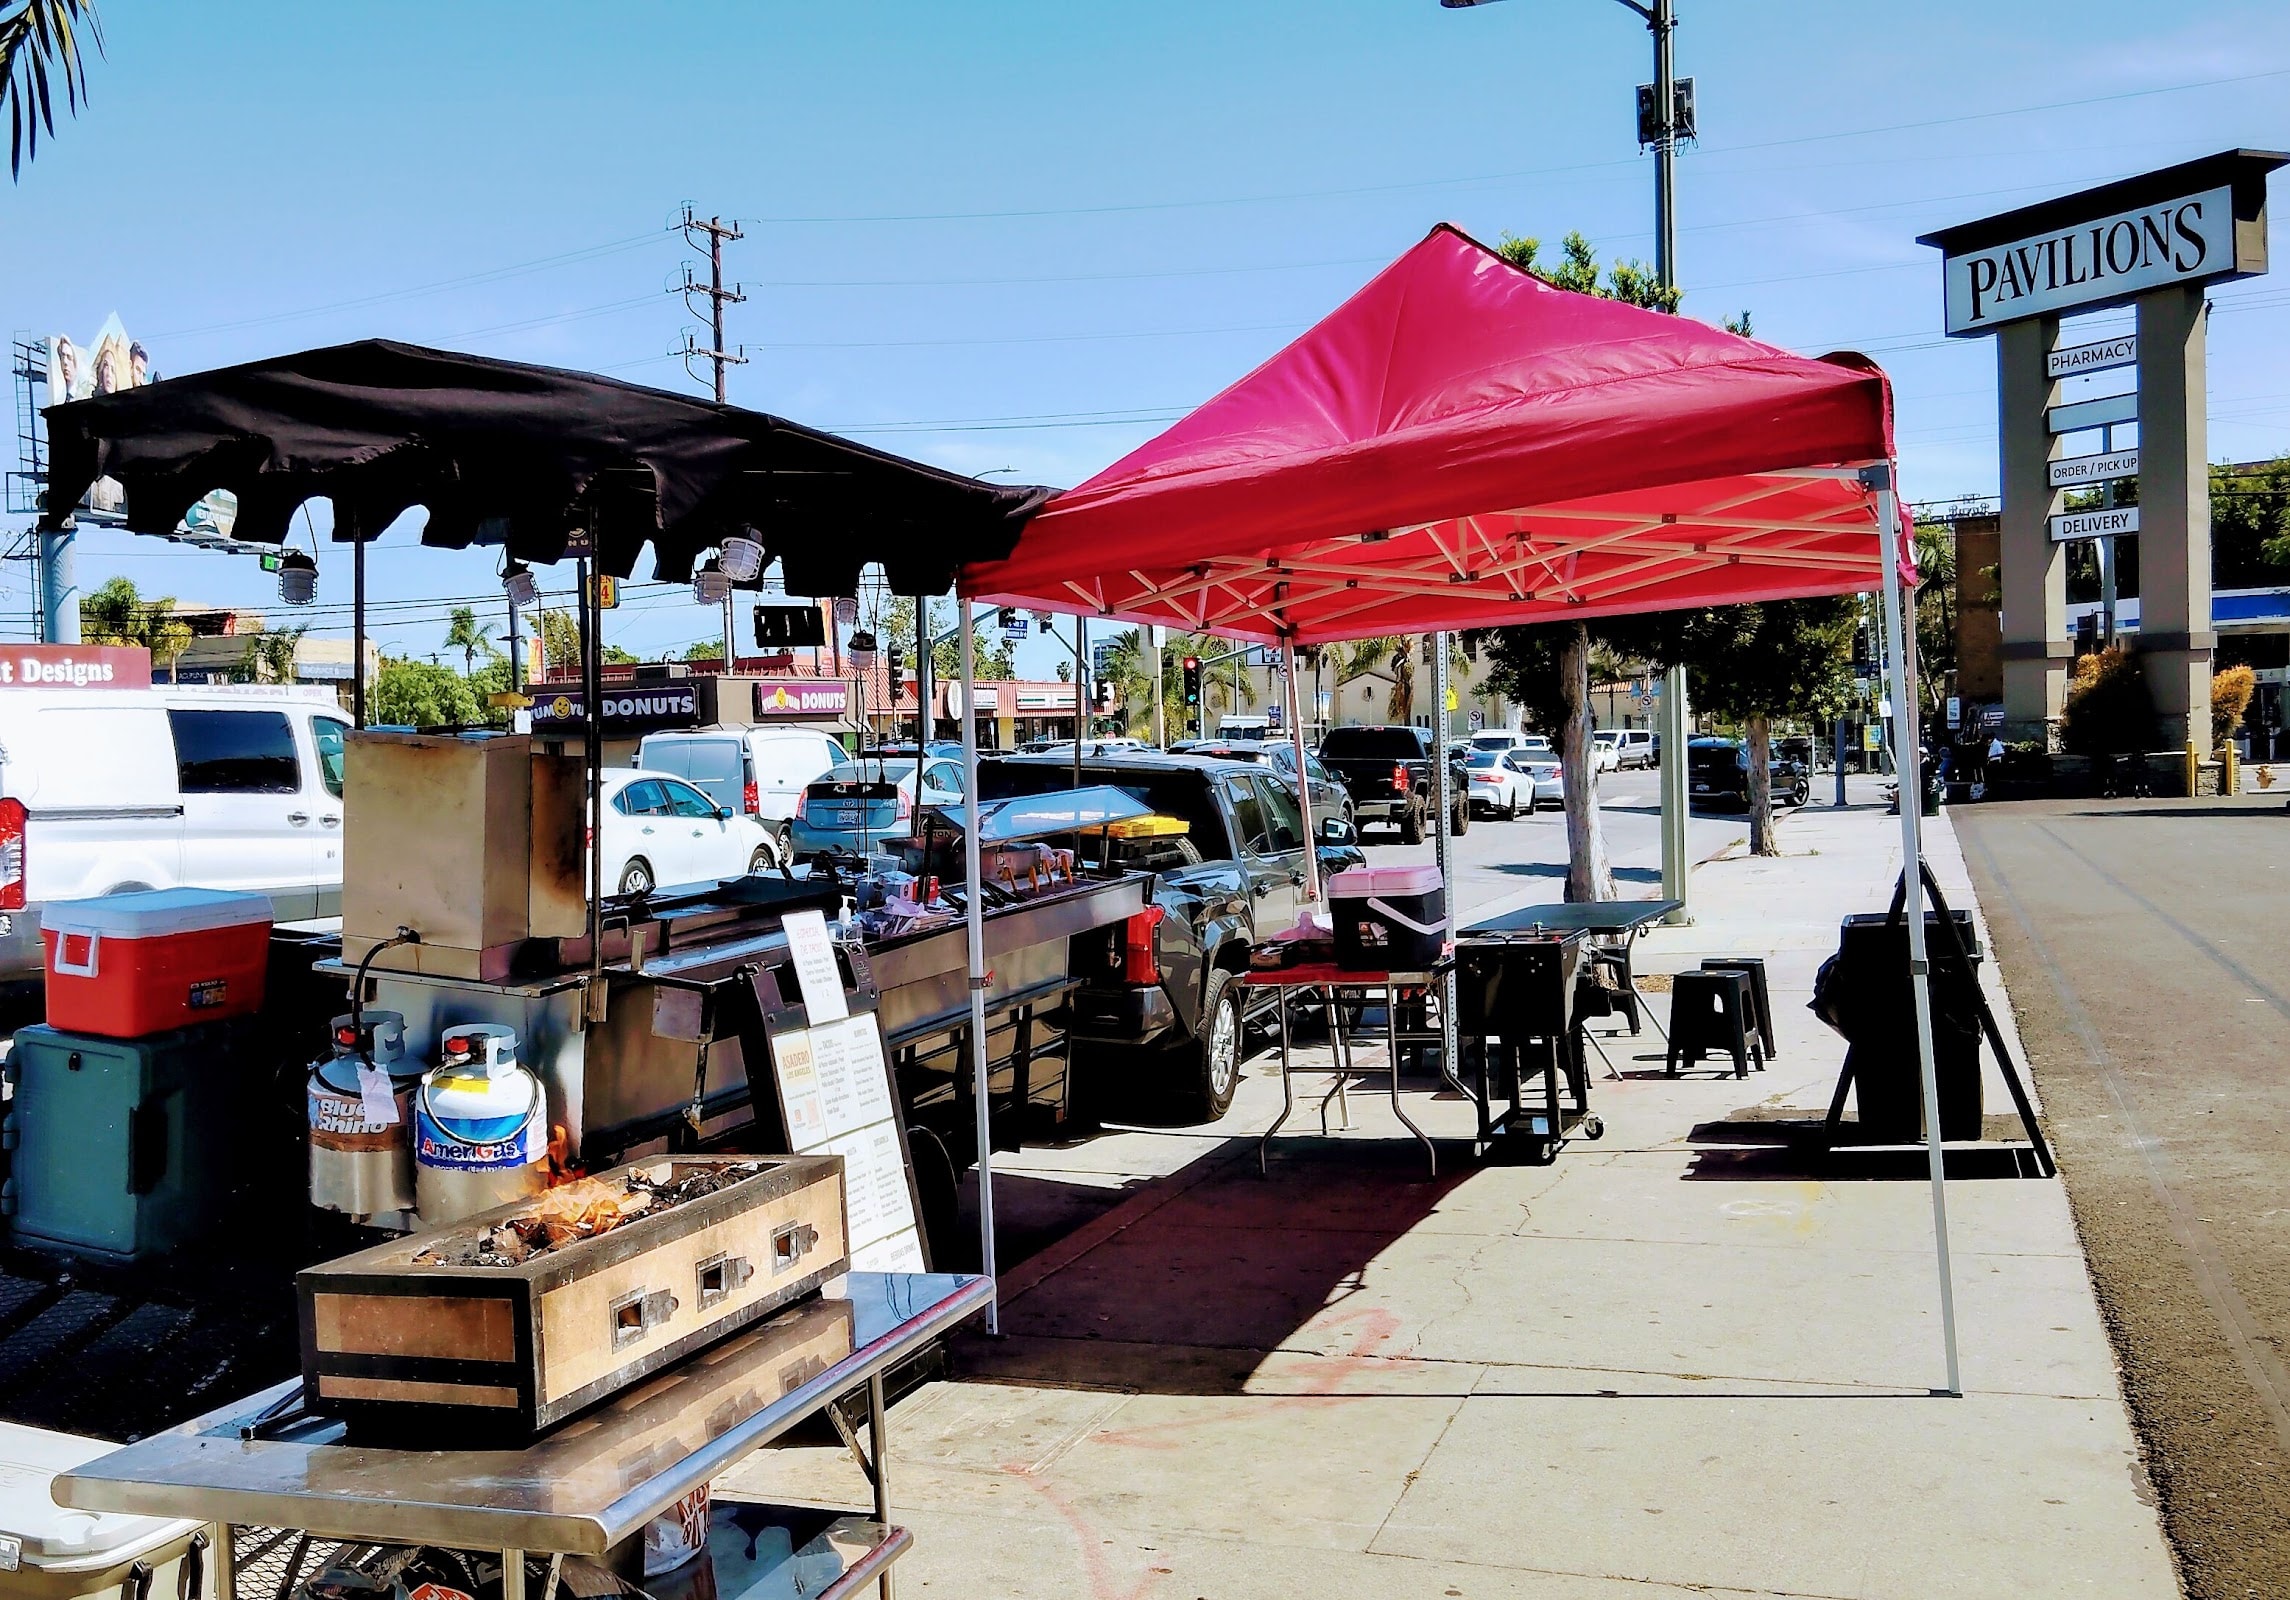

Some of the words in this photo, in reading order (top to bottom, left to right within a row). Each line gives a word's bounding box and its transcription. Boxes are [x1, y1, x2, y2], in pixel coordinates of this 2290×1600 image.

[1966, 202, 2207, 322] PAVILIONS
[2051, 340, 2135, 371] PHARMACY
[2053, 465, 2088, 479] ORDER
[2097, 460, 2121, 473] PICK
[2122, 457, 2137, 469] UP
[2062, 513, 2129, 535] DELIVERY
[20, 658, 114, 687] Designs
[570, 702, 585, 717] YU
[602, 695, 695, 717] DONUTS
[762, 694, 777, 712] YUM
[785, 694, 800, 712] YUM
[801, 692, 846, 710] DONUTS
[781, 1050, 811, 1070] ASADERO
[794, 1066, 812, 1077] ANGELES
[321, 1098, 366, 1118] Blue
[318, 1114, 389, 1135] Rhino
[422, 1138, 519, 1162] AmeriGas
